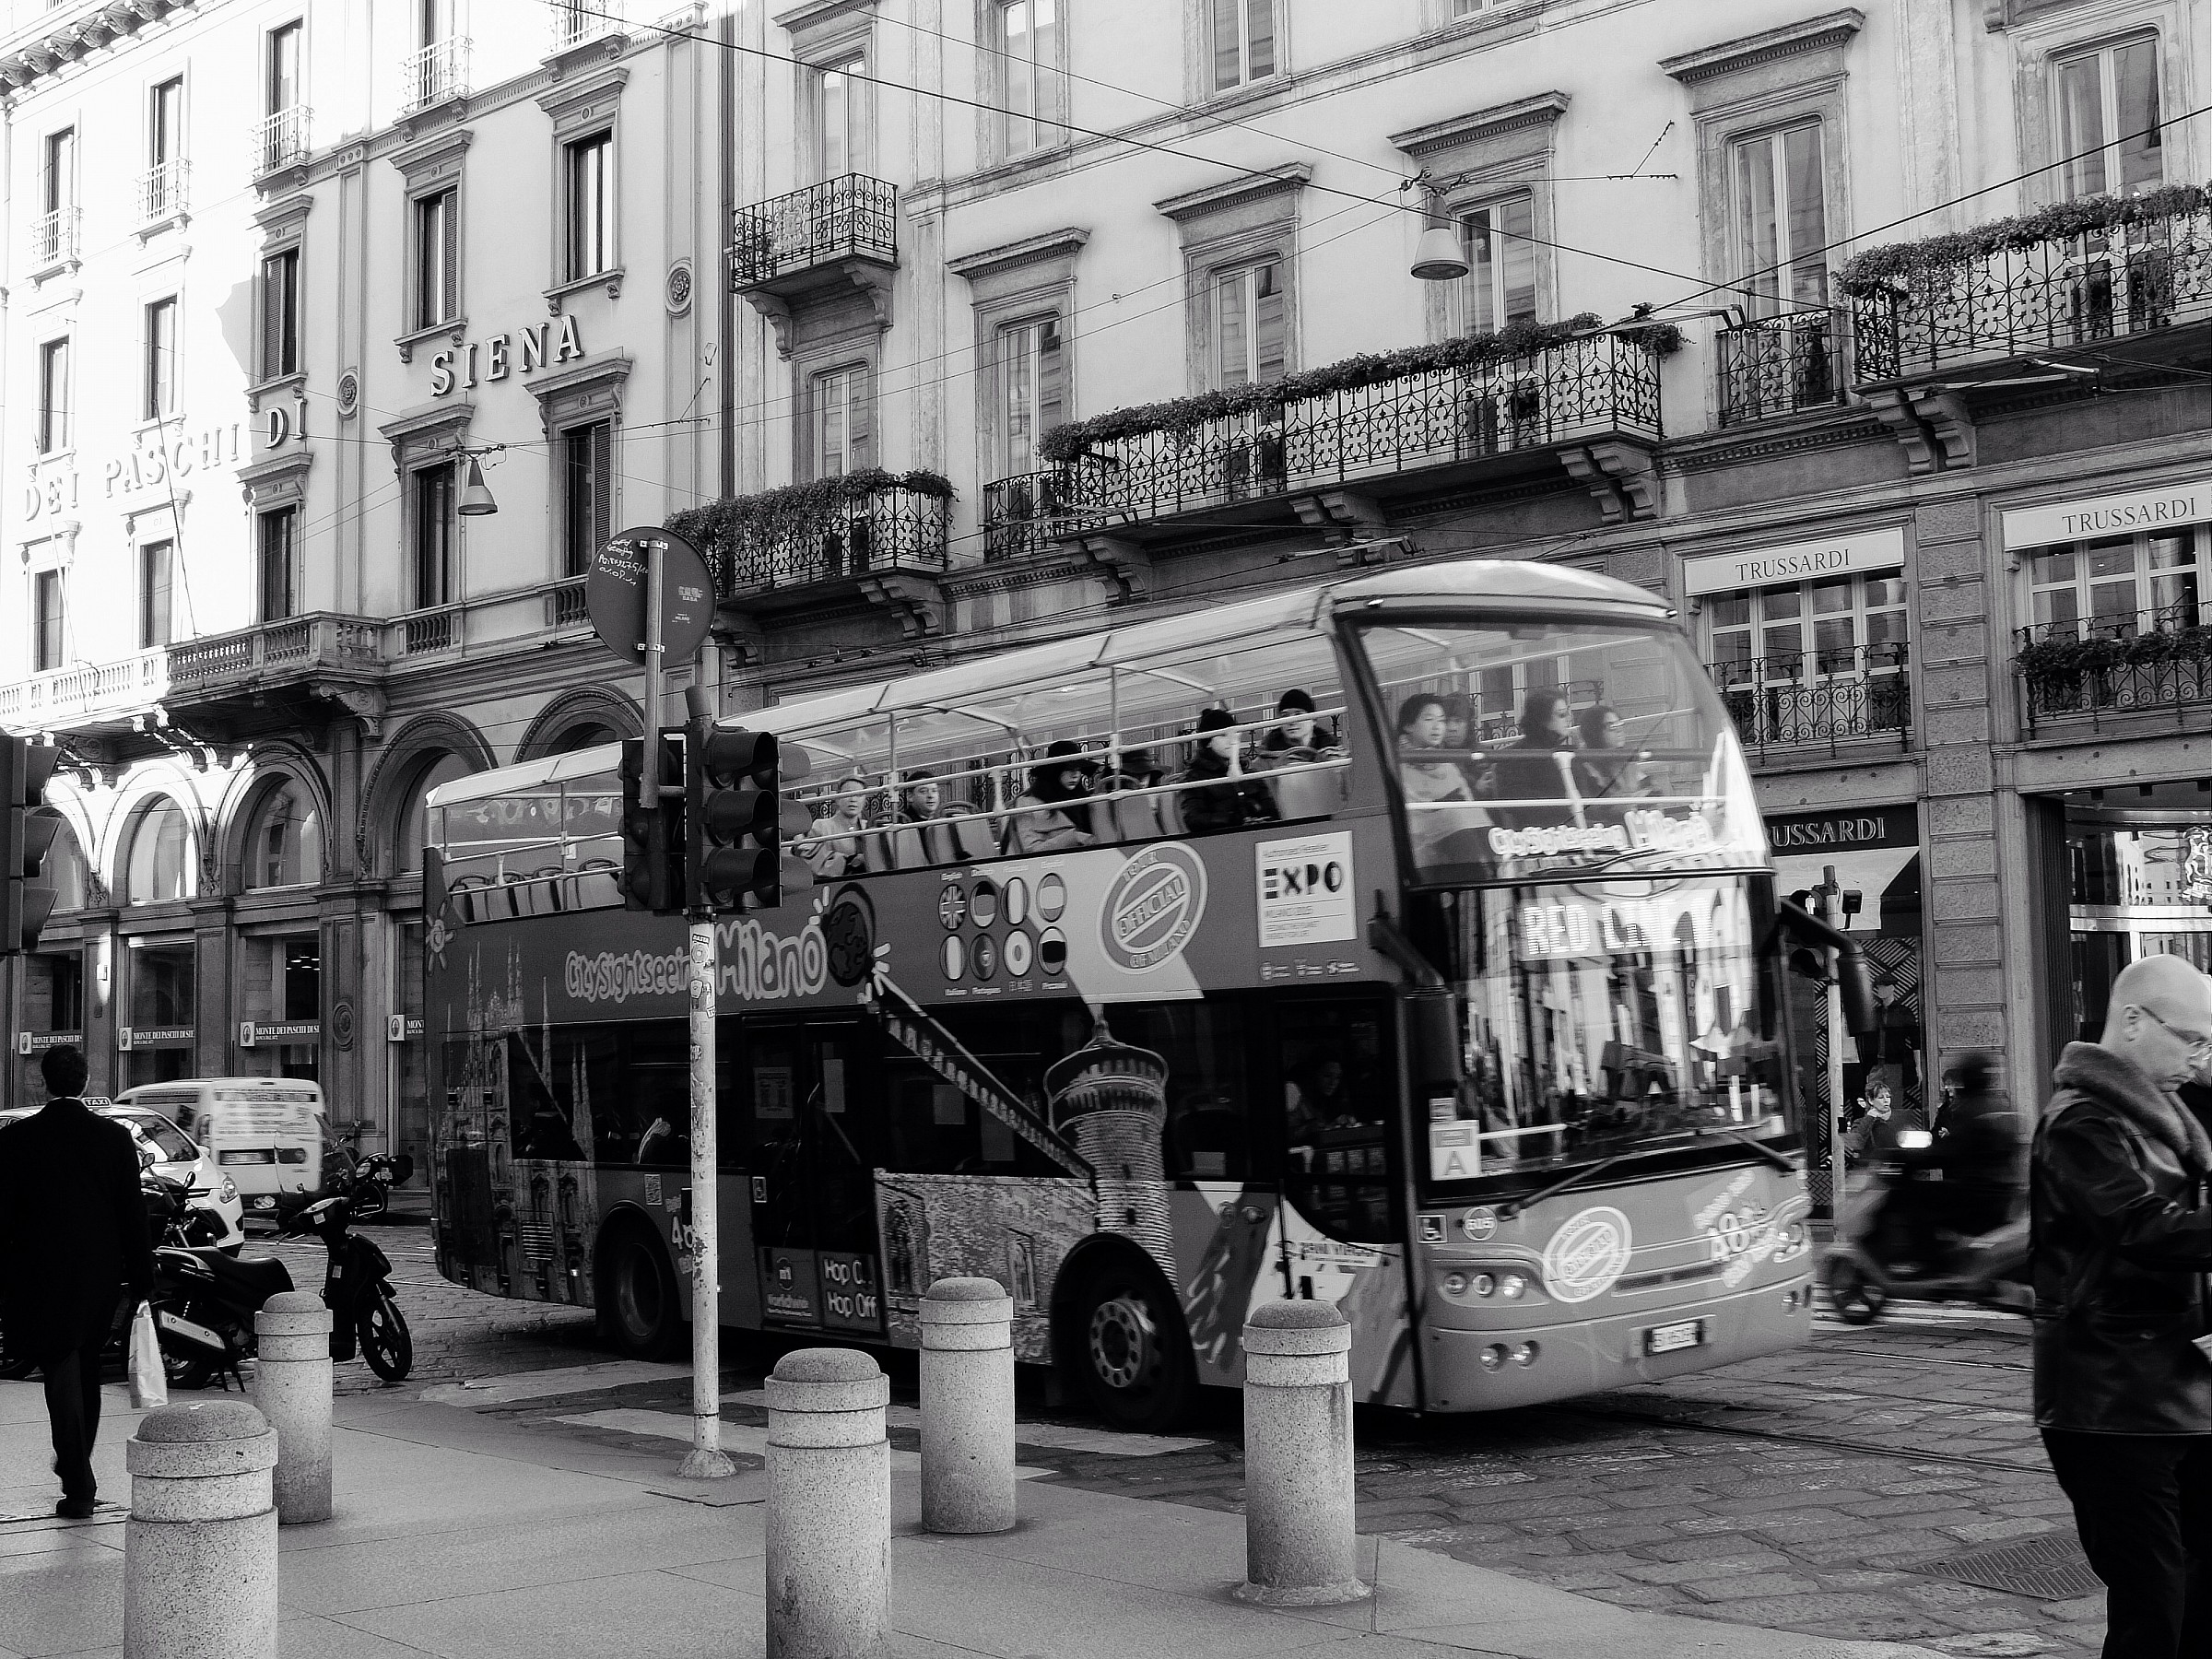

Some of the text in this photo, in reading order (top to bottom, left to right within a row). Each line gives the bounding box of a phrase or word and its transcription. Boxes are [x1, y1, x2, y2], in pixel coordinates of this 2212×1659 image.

[26, 314, 585, 522] DEI PASCHI DI SIENA
[2062, 496, 2196, 535] TRUSSARDI
[1735, 548, 1851, 582] TRUSSARDI
[1766, 817, 1888, 847] USSARDI
[1264, 860, 1343, 900] EXPO
[1523, 904, 1591, 955] RED
[715, 919, 829, 1001] Milano
[276, 1026, 286, 1034] DEI
[1443, 1150, 1467, 1176] A
[823, 1258, 851, 1286] Hop
[827, 1291, 854, 1319] Hop
[855, 1292, 877, 1318] Off
